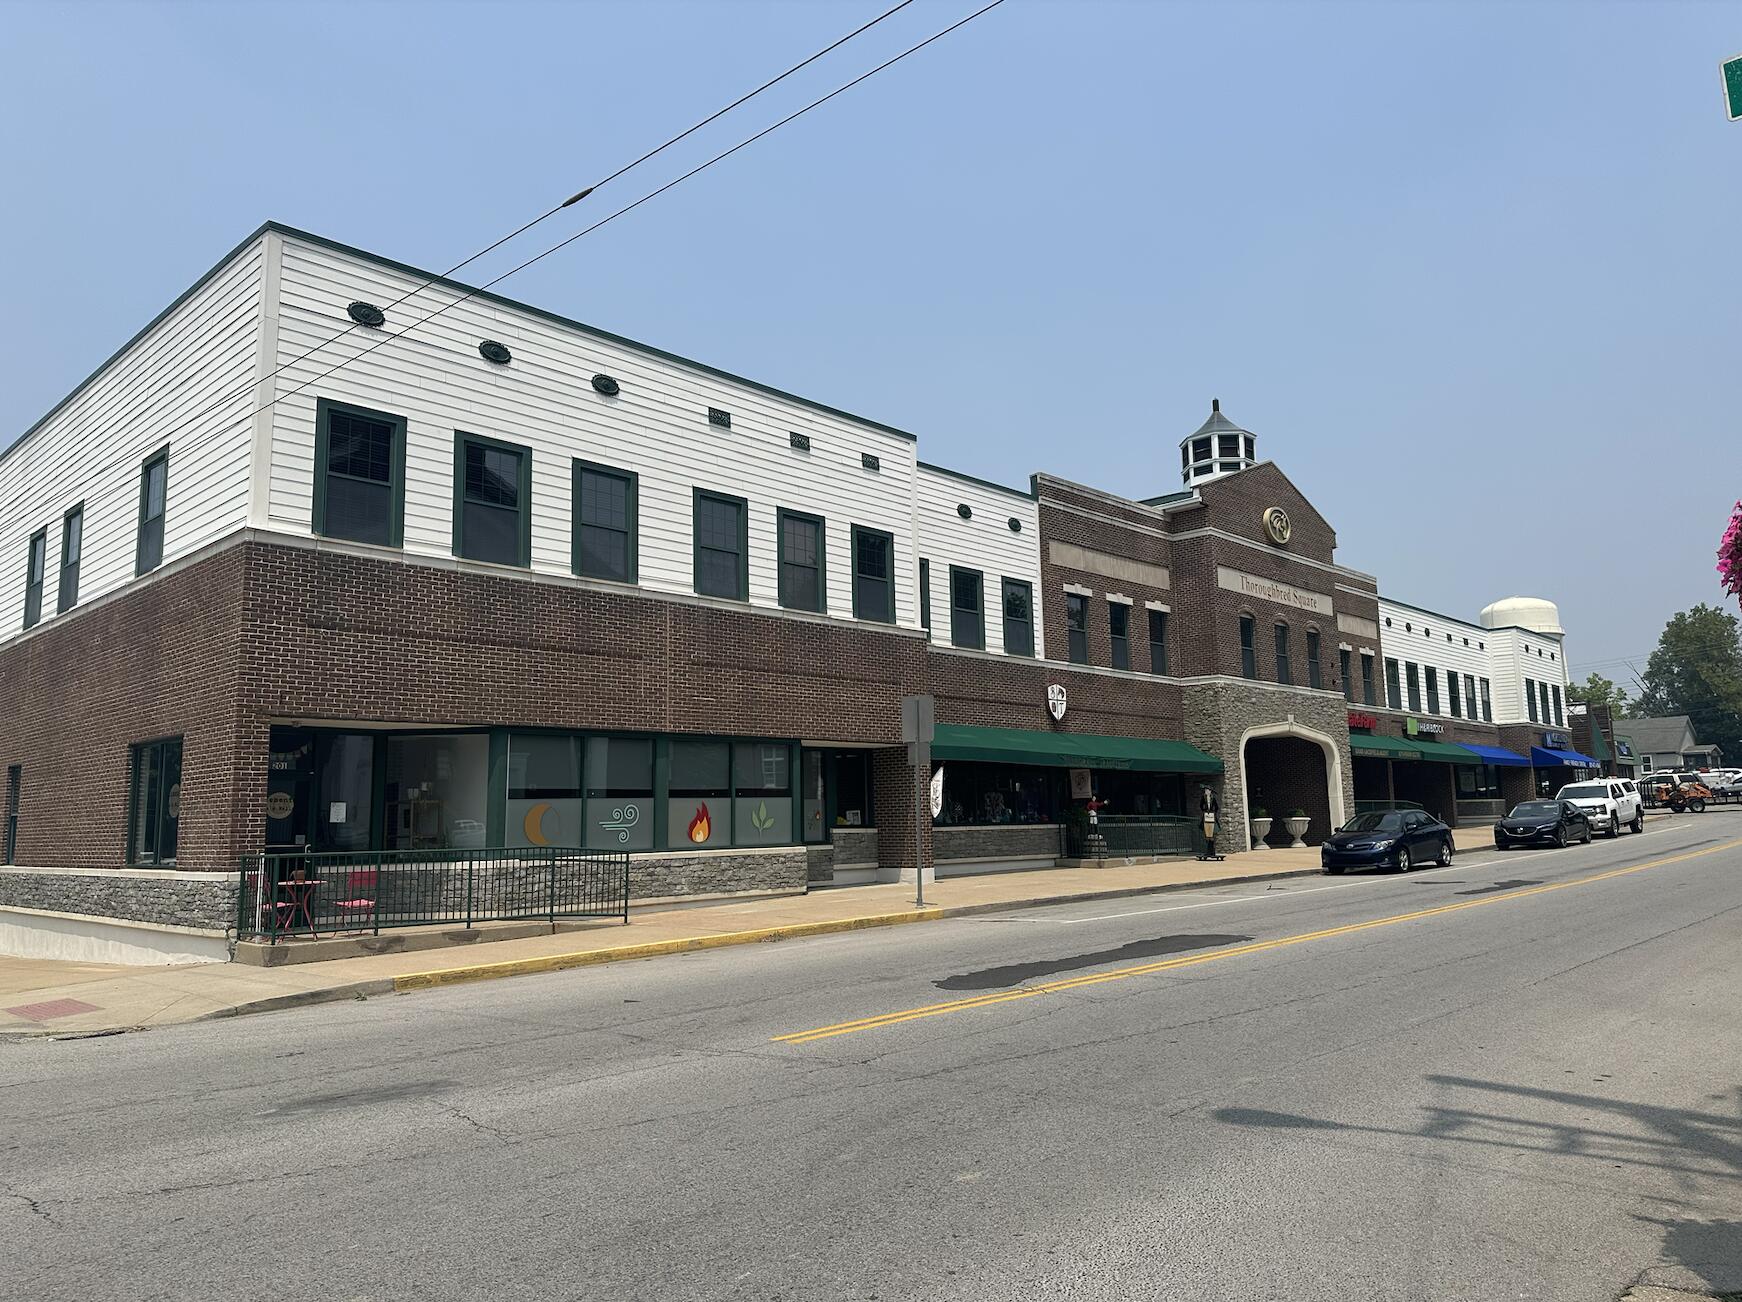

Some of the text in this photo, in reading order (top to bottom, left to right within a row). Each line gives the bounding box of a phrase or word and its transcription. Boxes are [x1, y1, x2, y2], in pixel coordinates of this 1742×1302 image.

[1240, 576, 1318, 609] Thoroughbred Square
[271, 762, 288, 770] 201
